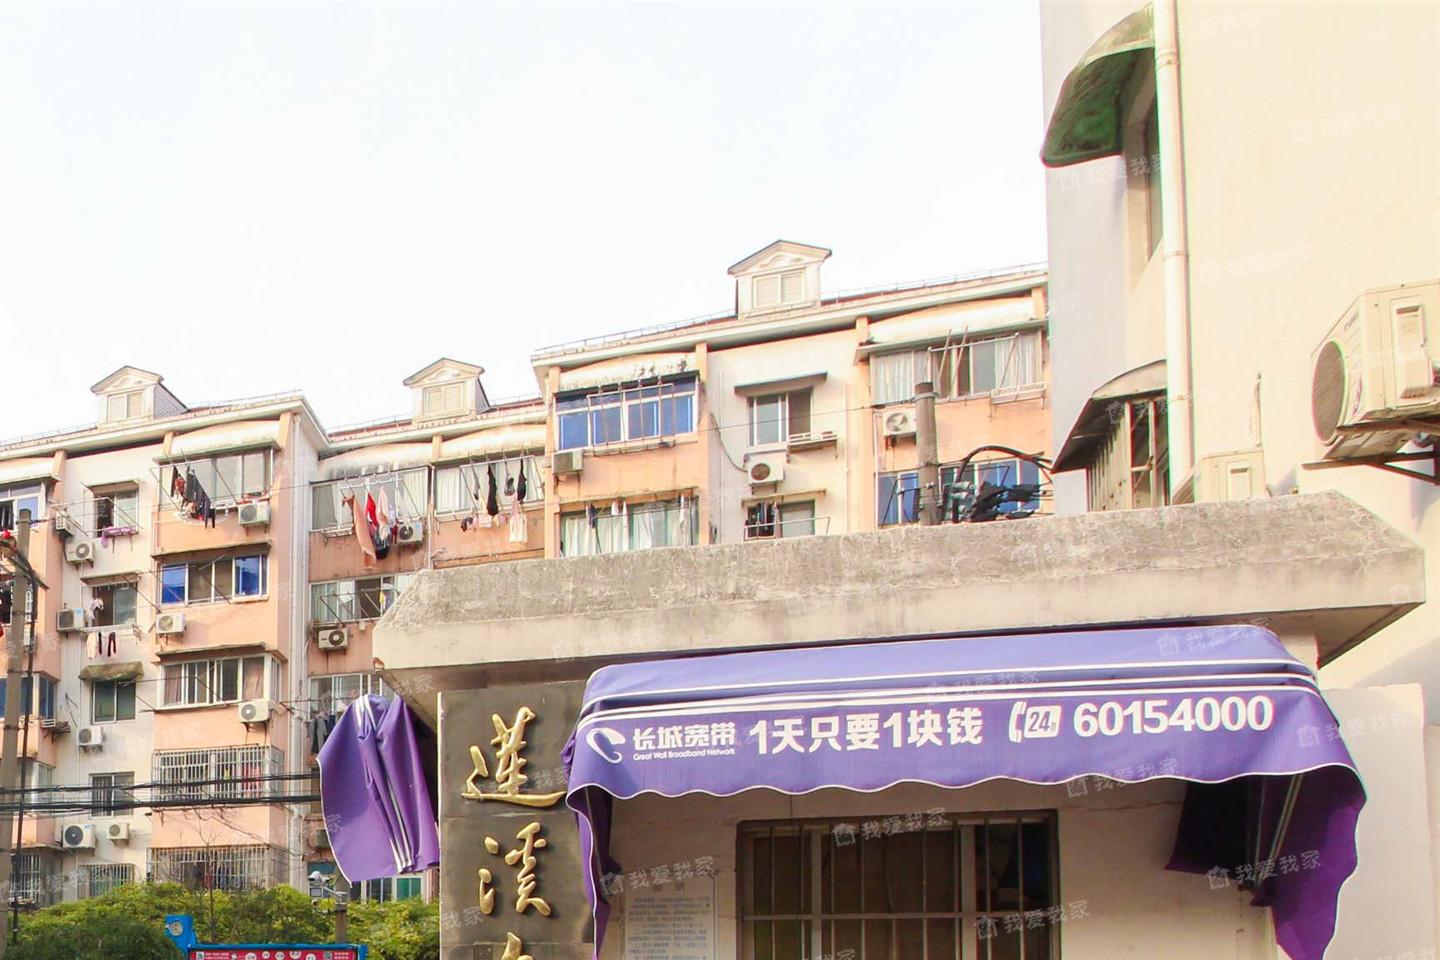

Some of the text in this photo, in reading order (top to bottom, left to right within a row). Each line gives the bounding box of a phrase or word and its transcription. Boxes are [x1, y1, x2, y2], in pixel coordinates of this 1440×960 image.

[749, 707, 984, 755] 1天只要1块钱
[1073, 695, 1274, 737] 60154000
[633, 722, 736, 750] 长城宽带
[633, 751, 652, 761] Great
[653, 750, 667, 760] Wall
[668, 749, 706, 759] Broadband
